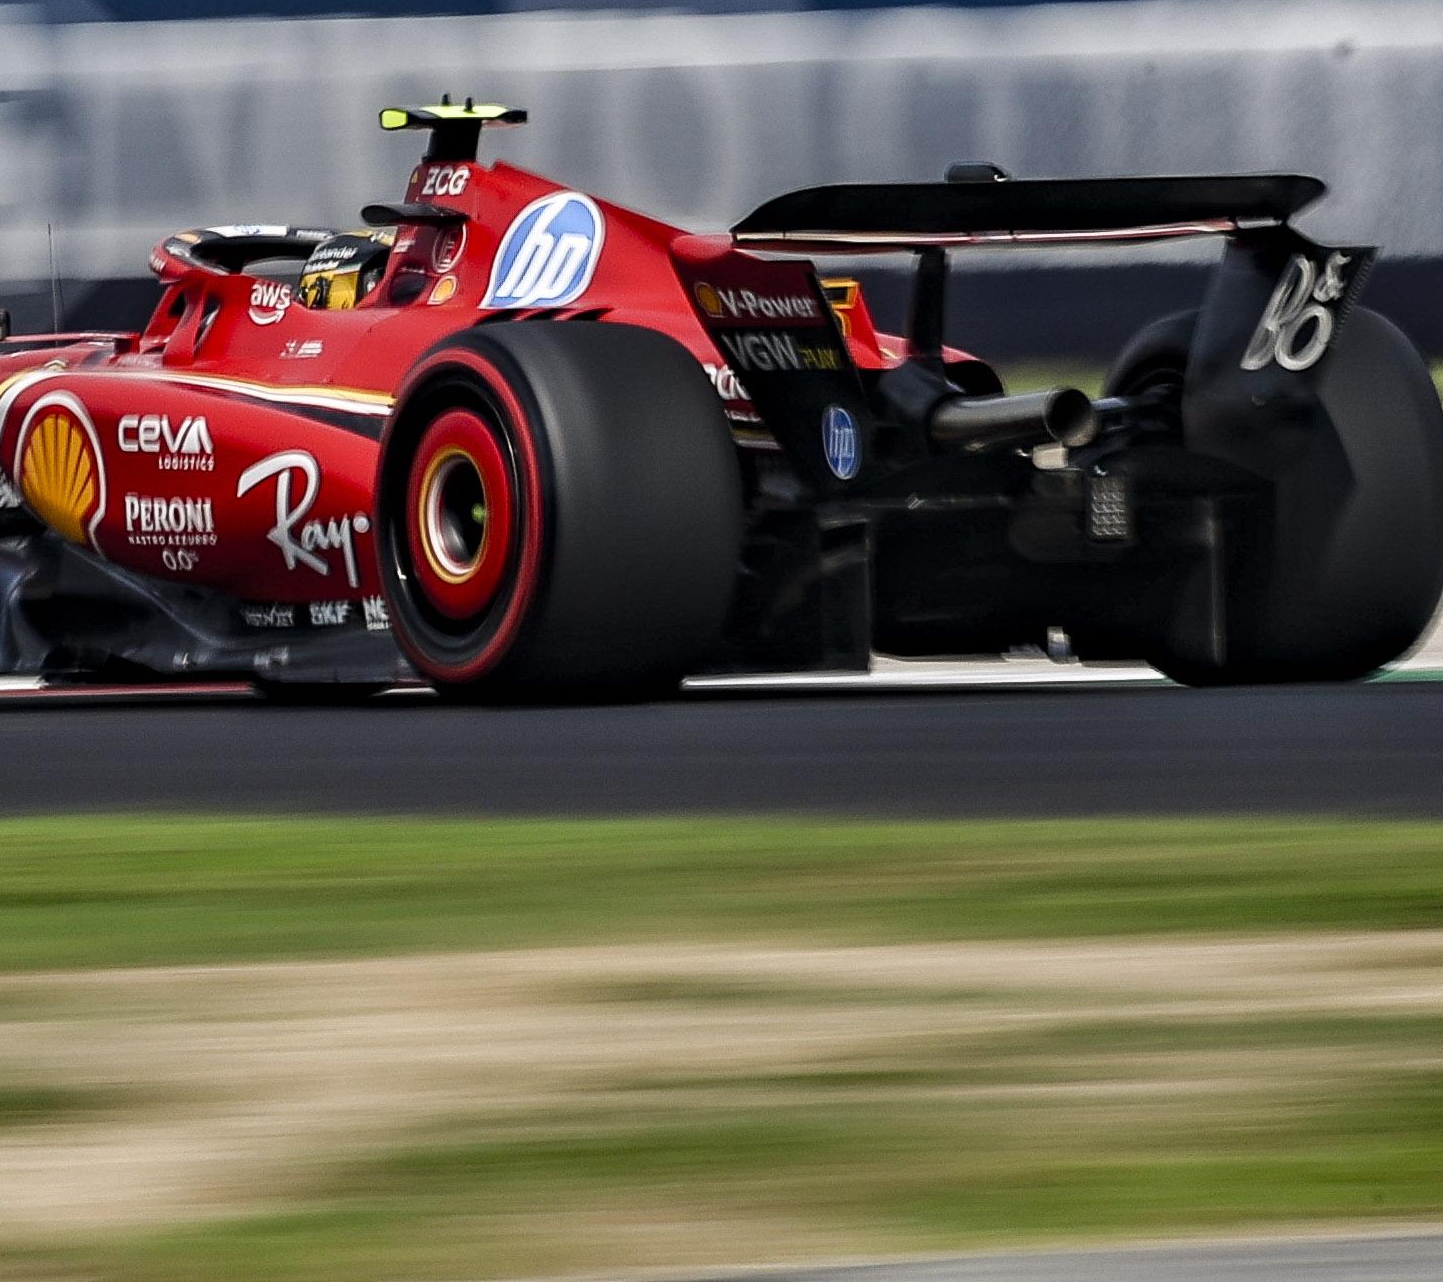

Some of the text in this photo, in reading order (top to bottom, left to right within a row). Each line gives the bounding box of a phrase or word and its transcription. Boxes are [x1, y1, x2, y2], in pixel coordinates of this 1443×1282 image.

[487, 192, 595, 308] hp
[250, 282, 292, 310] aws
[718, 289, 819, 319] V-Power
[720, 332, 802, 371] VGW
[158, 455, 215, 471] LOGISTICS
[124, 493, 214, 532] PERONI
